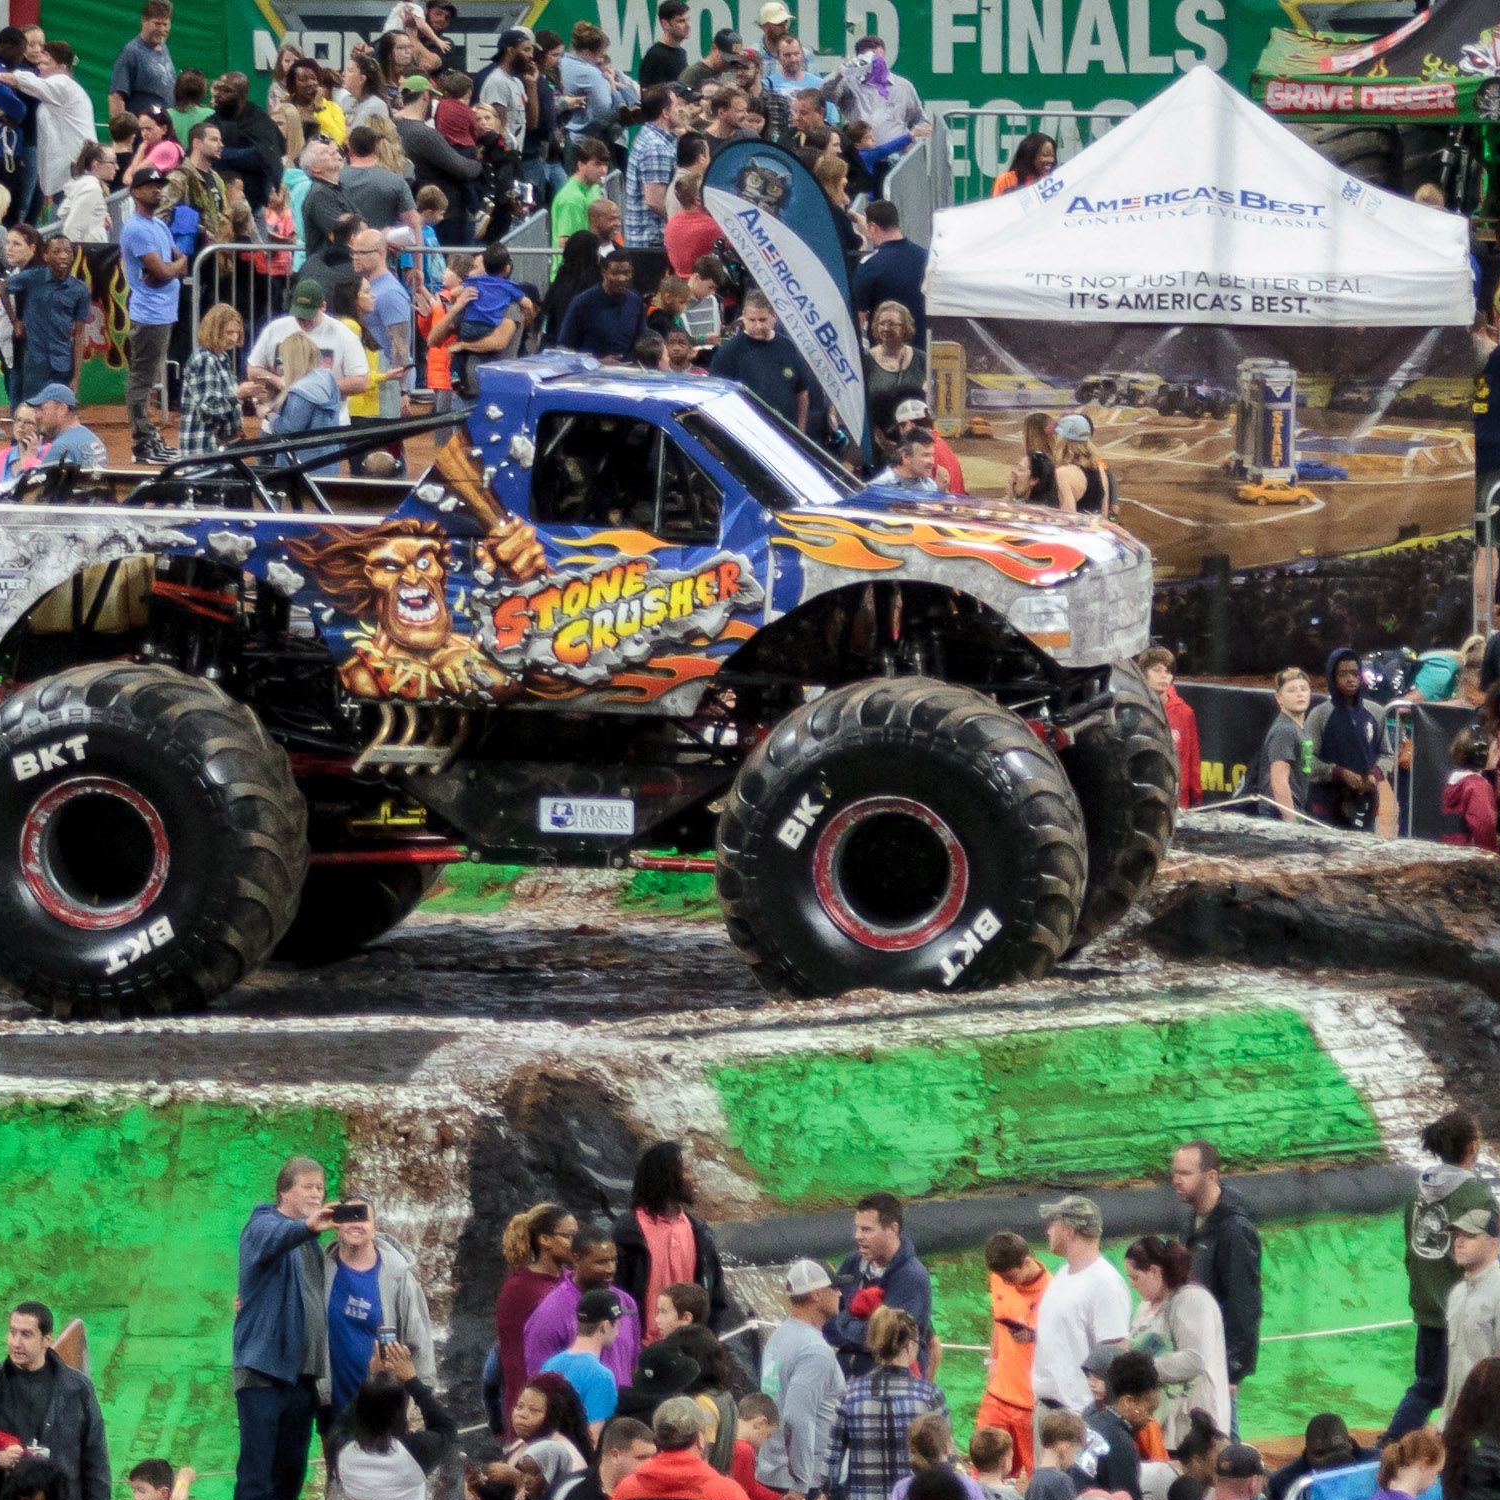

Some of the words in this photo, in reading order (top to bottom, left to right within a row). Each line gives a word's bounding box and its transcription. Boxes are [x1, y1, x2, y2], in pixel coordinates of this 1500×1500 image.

[931, 0, 1227, 74] FINALS
[1265, 80, 1355, 113] GRAVE
[1359, 82, 1458, 113] DIGGER
[1065, 185, 1236, 214] AMERICA'S
[1239, 189, 1326, 217] BEST
[737, 208, 821, 327] AMERICA'S
[813, 320, 859, 385] BEST
[1068, 290, 1110, 311] IT'S
[1116, 292, 1242, 313] AMERICA'S
[1080, 274, 1127, 289] NOT
[1136, 271, 1190, 289] JUST
[1194, 270, 1211, 289] A
[1218, 272, 1299, 293] BETTER
[493, 559, 651, 651] STONE
[552, 560, 742, 666] CRUSHER
[12, 734, 90, 782] BKT
[777, 778, 830, 850] BK
[105, 915, 175, 976] BKT
[940, 908, 1003, 987] BKT
